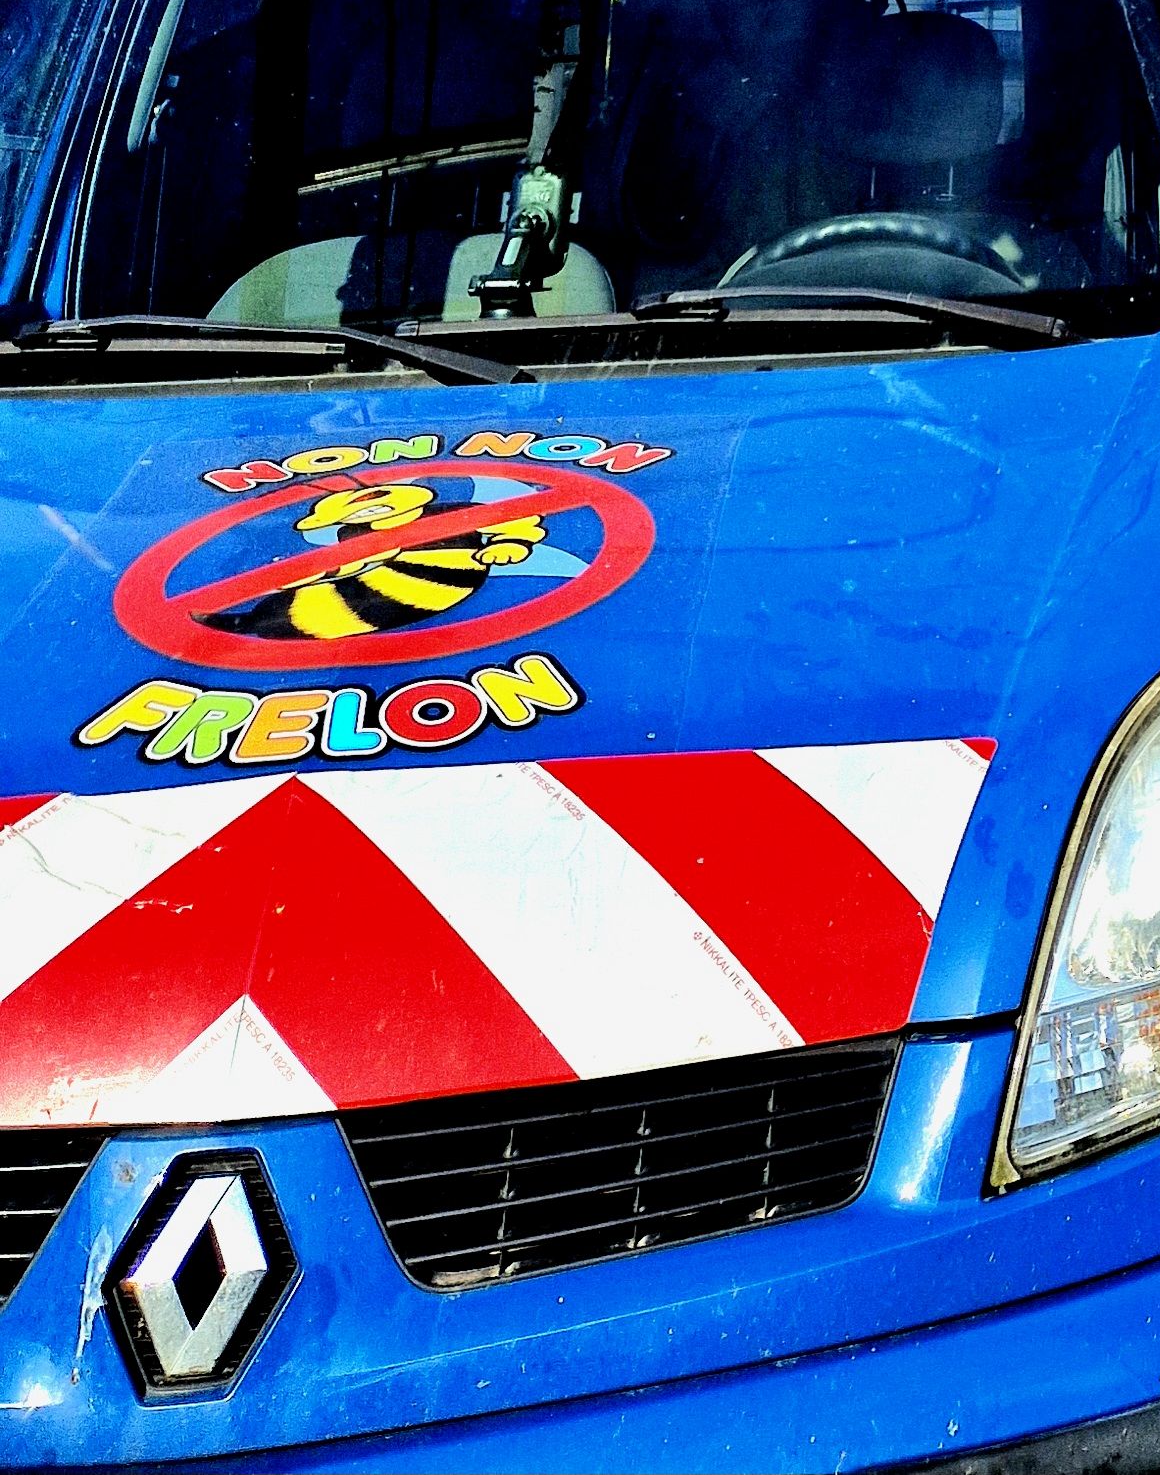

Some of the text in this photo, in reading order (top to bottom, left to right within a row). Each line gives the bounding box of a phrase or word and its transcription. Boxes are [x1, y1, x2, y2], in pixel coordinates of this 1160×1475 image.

[203, 431, 672, 492] NON NON
[77, 655, 579, 764] FRELON
[700, 935, 746, 990] NIKKALITE
[744, 988, 771, 1022] TPESC
